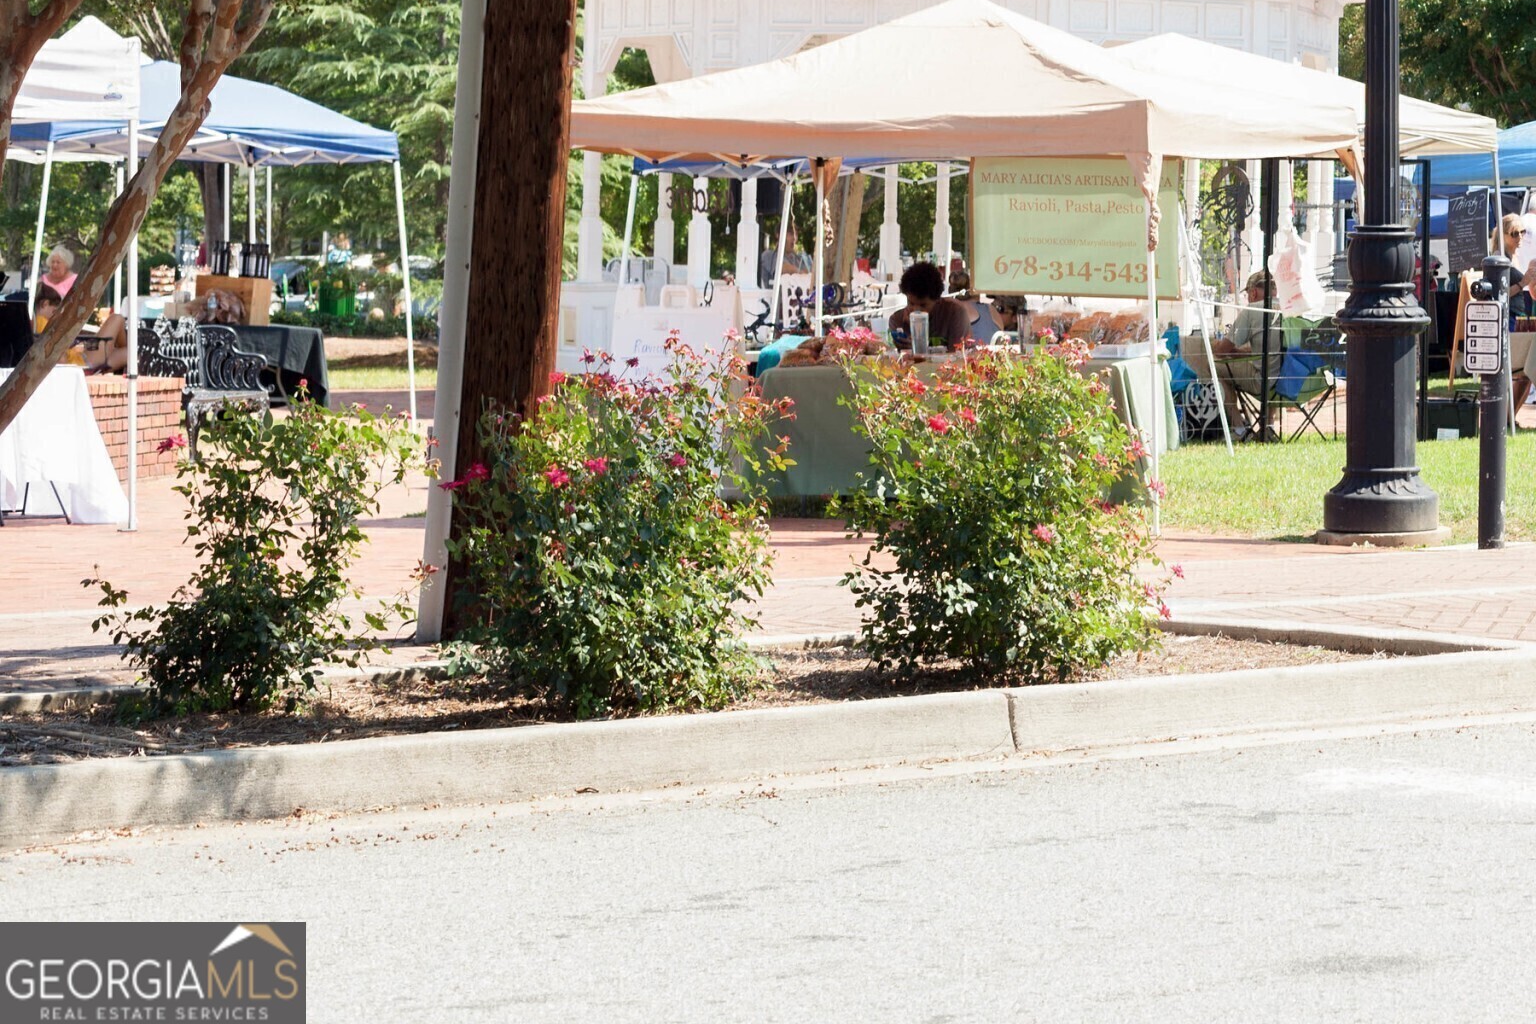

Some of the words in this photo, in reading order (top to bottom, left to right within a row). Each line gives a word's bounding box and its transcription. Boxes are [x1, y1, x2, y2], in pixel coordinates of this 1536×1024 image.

[980, 172, 1017, 184] MARY
[1019, 173, 1072, 185] ALICIA'S
[1074, 175, 1129, 188] ARTISAN
[1008, 197, 1061, 214] Ravioli,
[1449, 193, 1487, 215] Thirsty?
